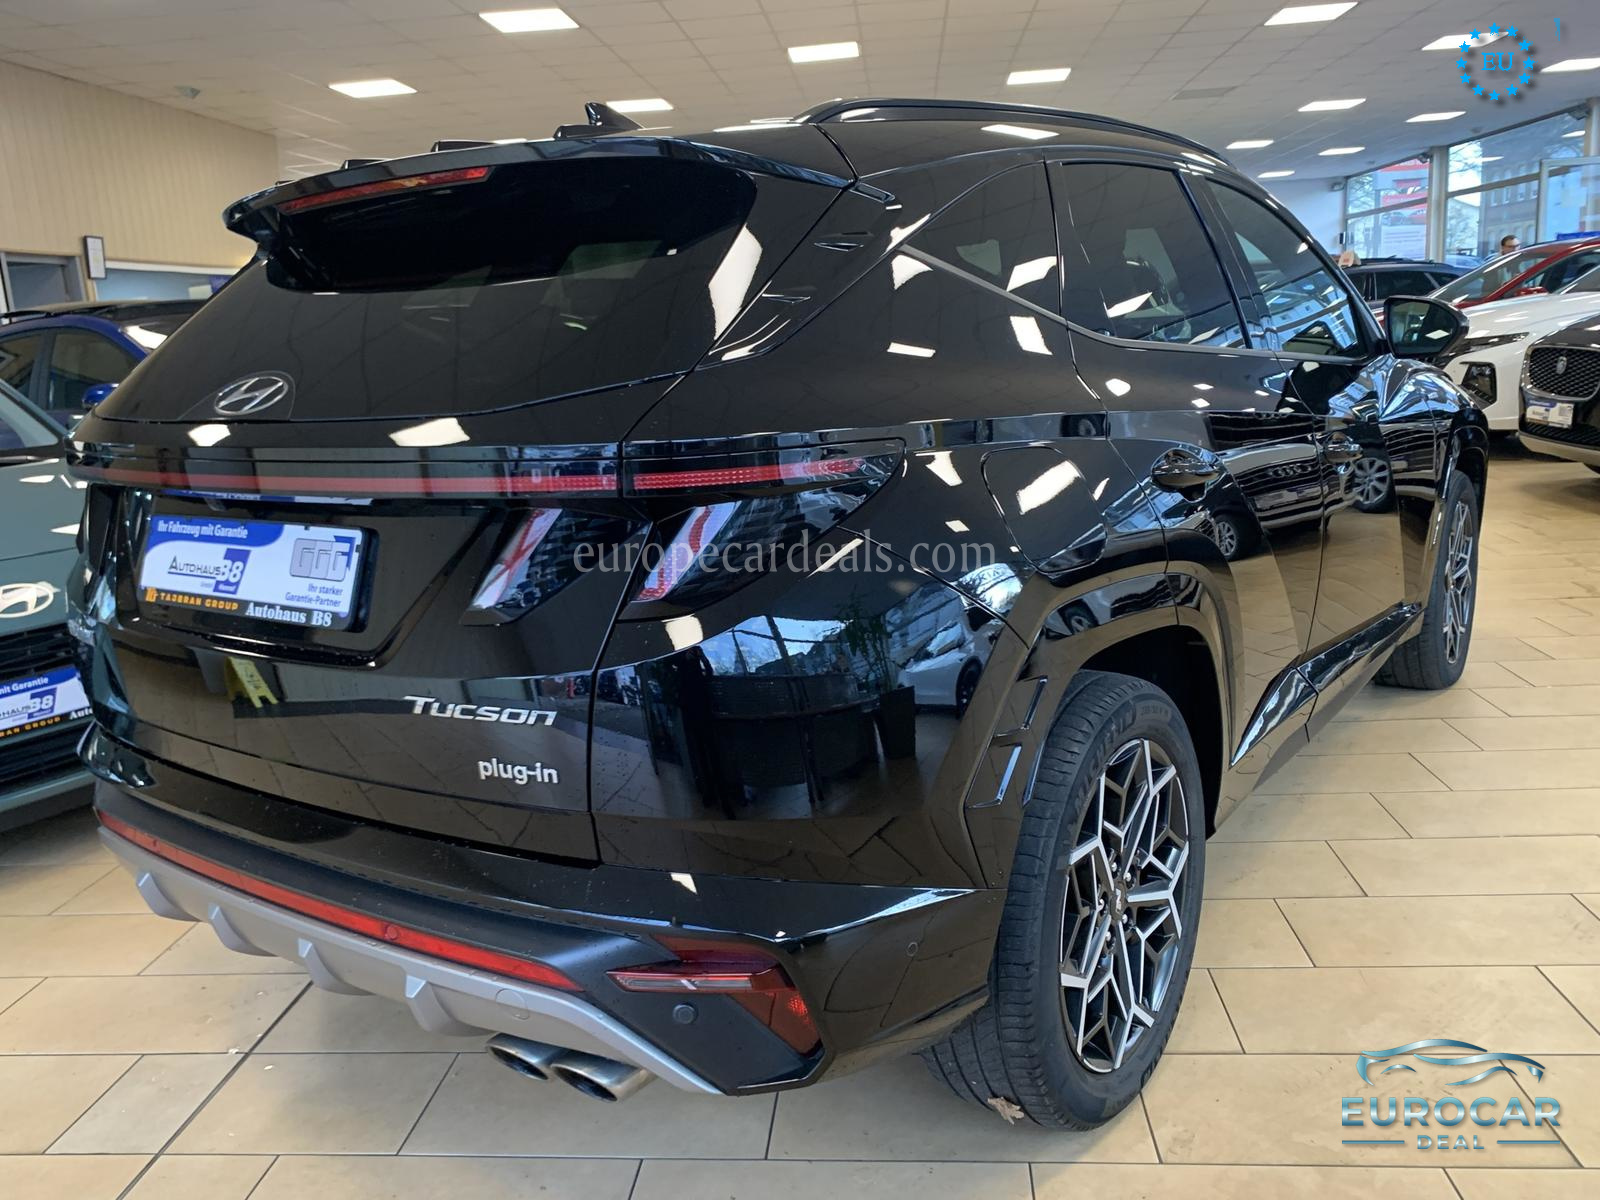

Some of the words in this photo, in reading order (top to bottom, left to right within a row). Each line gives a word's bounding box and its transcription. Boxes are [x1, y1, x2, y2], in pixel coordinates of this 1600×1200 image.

[158, 519, 168, 532] Ihr
[168, 520, 200, 538] Fahrzeug
[201, 523, 214, 536] mit
[215, 524, 248, 539] Garantie
[285, 591, 342, 608] Garantie-Partner
[245, 602, 307, 624] Autohaus
[12, 677, 49, 691] Garantie
[478, 758, 559, 785] plug-in
